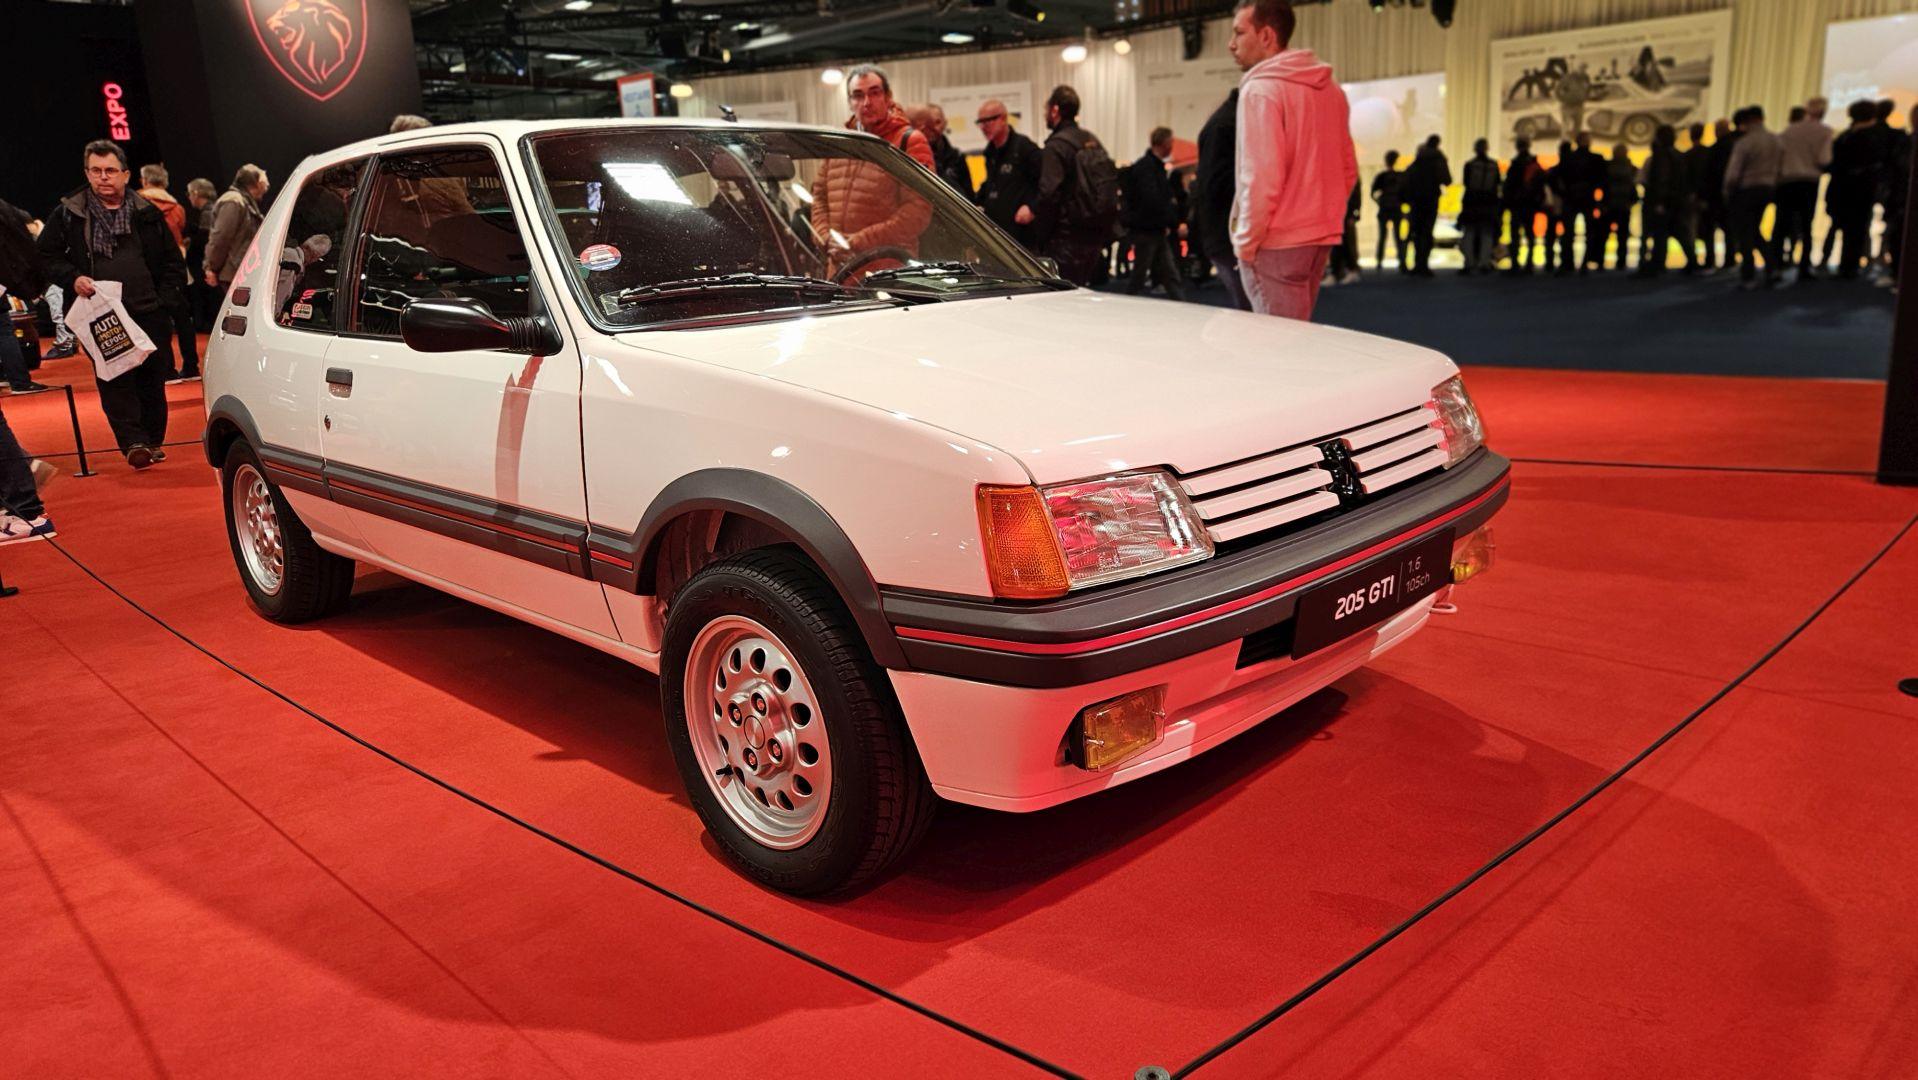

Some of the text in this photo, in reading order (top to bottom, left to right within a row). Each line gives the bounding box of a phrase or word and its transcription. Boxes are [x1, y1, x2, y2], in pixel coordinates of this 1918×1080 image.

[104, 83, 131, 140] EXPO
[94, 315, 119, 336] AUTO
[1408, 556, 1421, 573] 1.6
[1406, 572, 1430, 592] 105ch
[1335, 575, 1394, 620] 205 GTI
